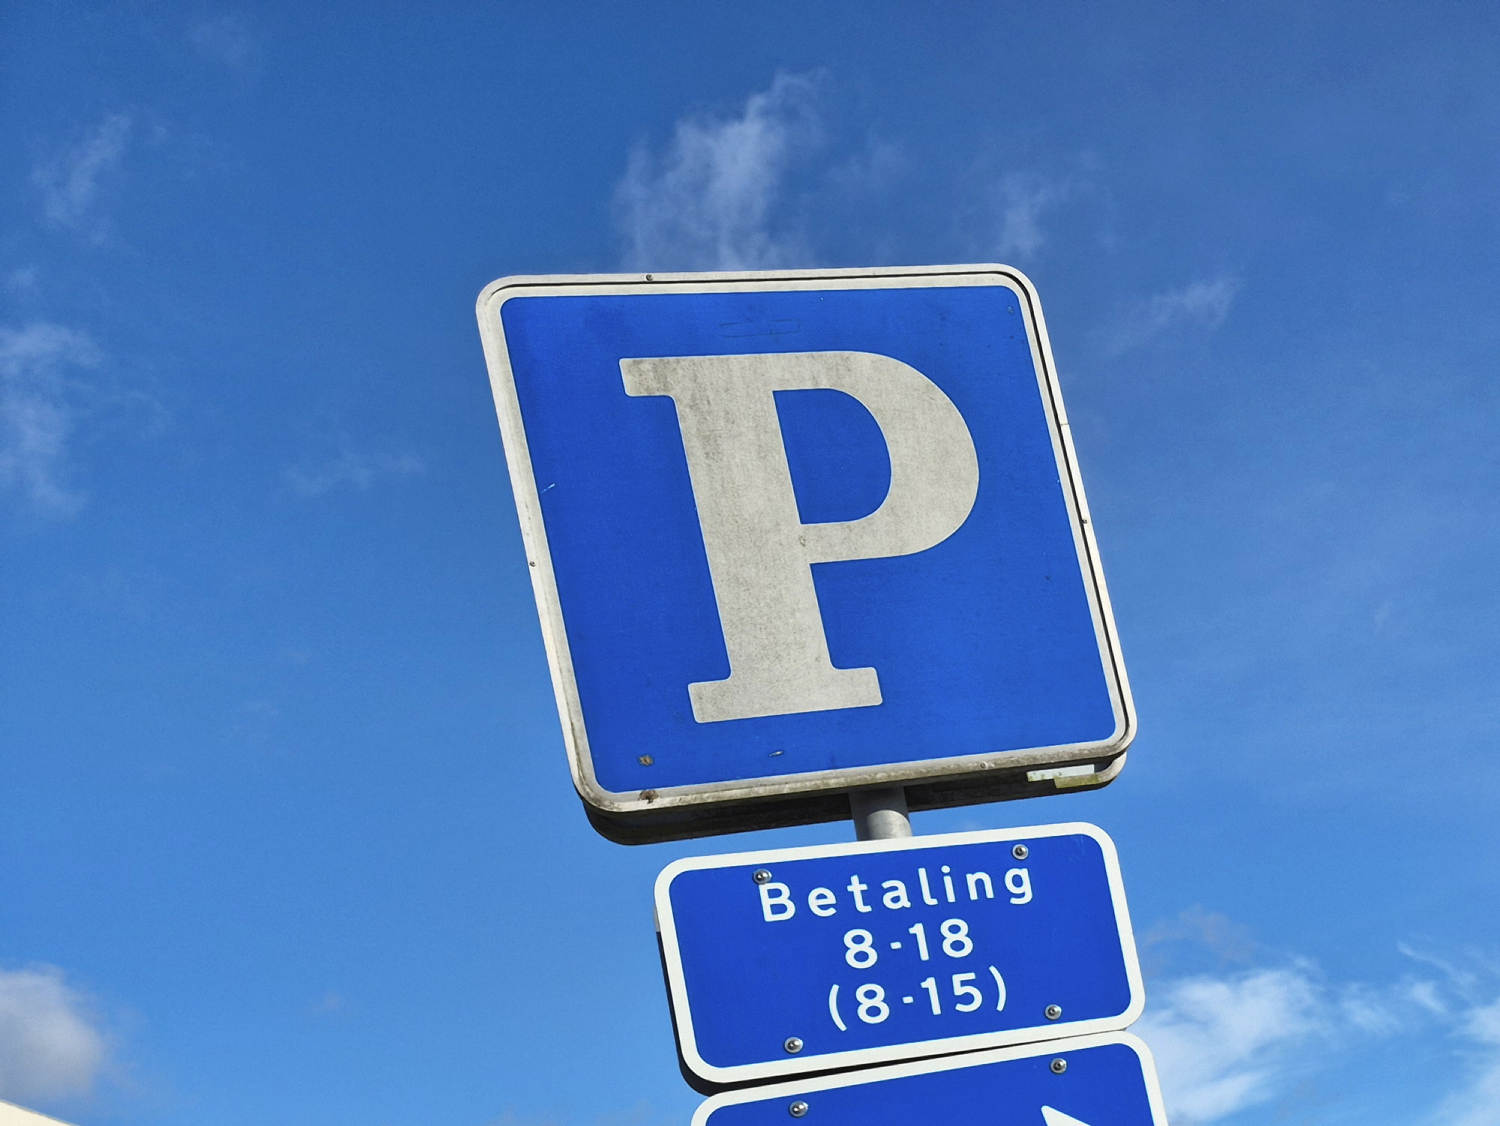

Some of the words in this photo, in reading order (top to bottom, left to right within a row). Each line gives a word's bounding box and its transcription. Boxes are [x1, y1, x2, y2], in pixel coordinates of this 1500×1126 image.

[619, 351, 979, 723] P
[758, 865, 1033, 923] Betaling
[843, 918, 974, 969] 8-18
[828, 965, 1007, 1032] (8-15)
